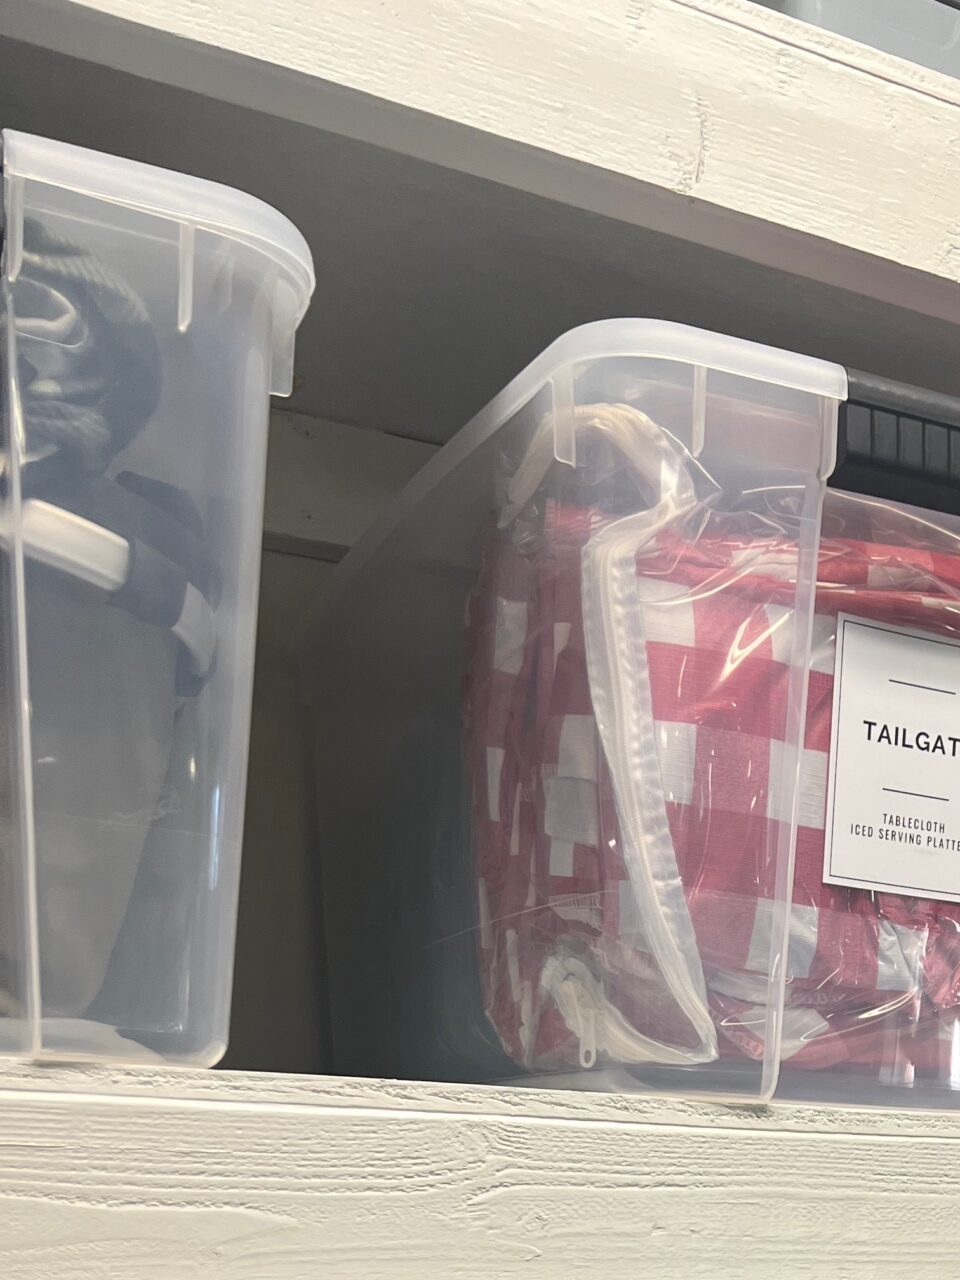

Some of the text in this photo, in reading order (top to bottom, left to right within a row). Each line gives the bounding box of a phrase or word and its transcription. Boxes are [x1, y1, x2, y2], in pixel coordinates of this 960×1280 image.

[850, 823, 874, 838] ICED
[878, 828, 922, 846] SERVING
[882, 813, 946, 834] TABLECLOTH
